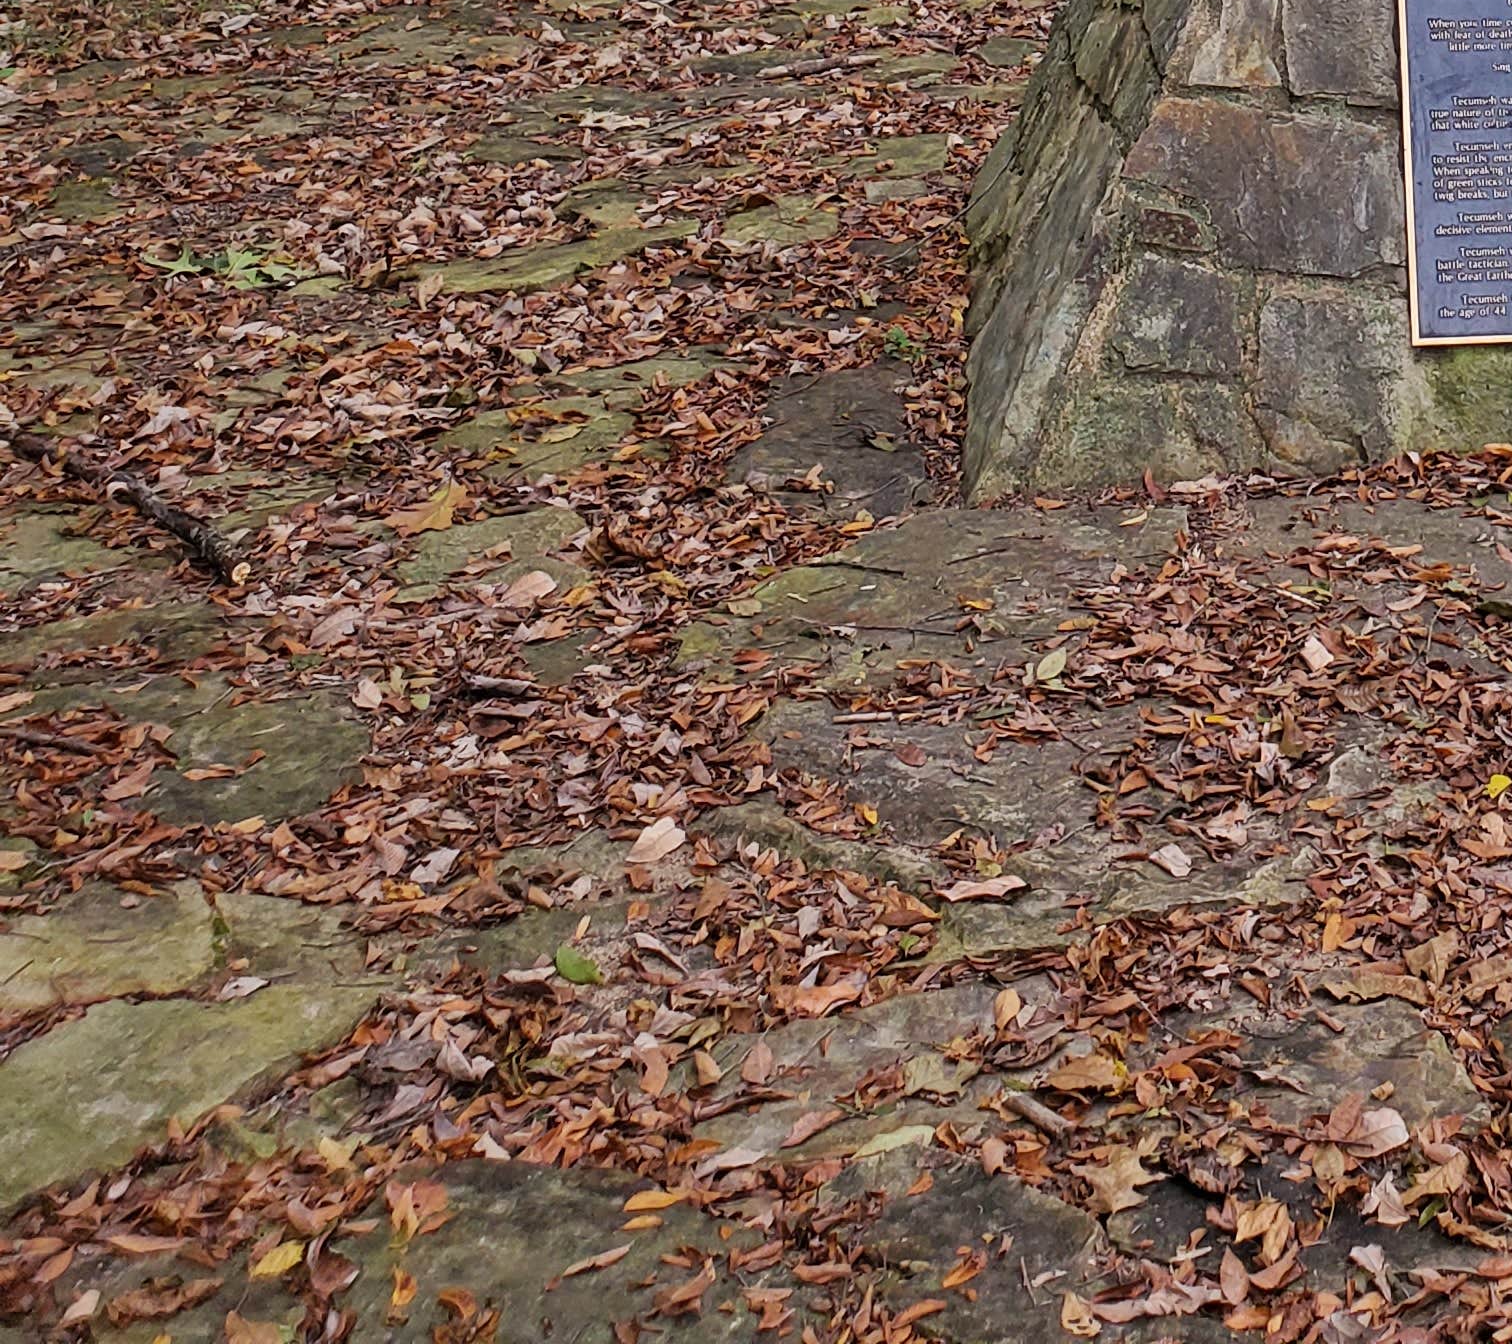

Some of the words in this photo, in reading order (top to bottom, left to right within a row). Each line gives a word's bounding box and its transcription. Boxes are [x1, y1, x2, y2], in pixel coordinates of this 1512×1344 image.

[1458, 211, 1503, 222] Tecumseh
[1435, 224, 1472, 235] decisive
[1475, 223, 1512, 233] element
[1437, 259, 1465, 270] battle
[1438, 271, 1454, 281] the
[1457, 271, 1482, 281] Great
[1461, 293, 1508, 304] Tecumseh
[1438, 307, 1456, 317] the
[1458, 308, 1474, 318] age
[1479, 306, 1490, 315] of
